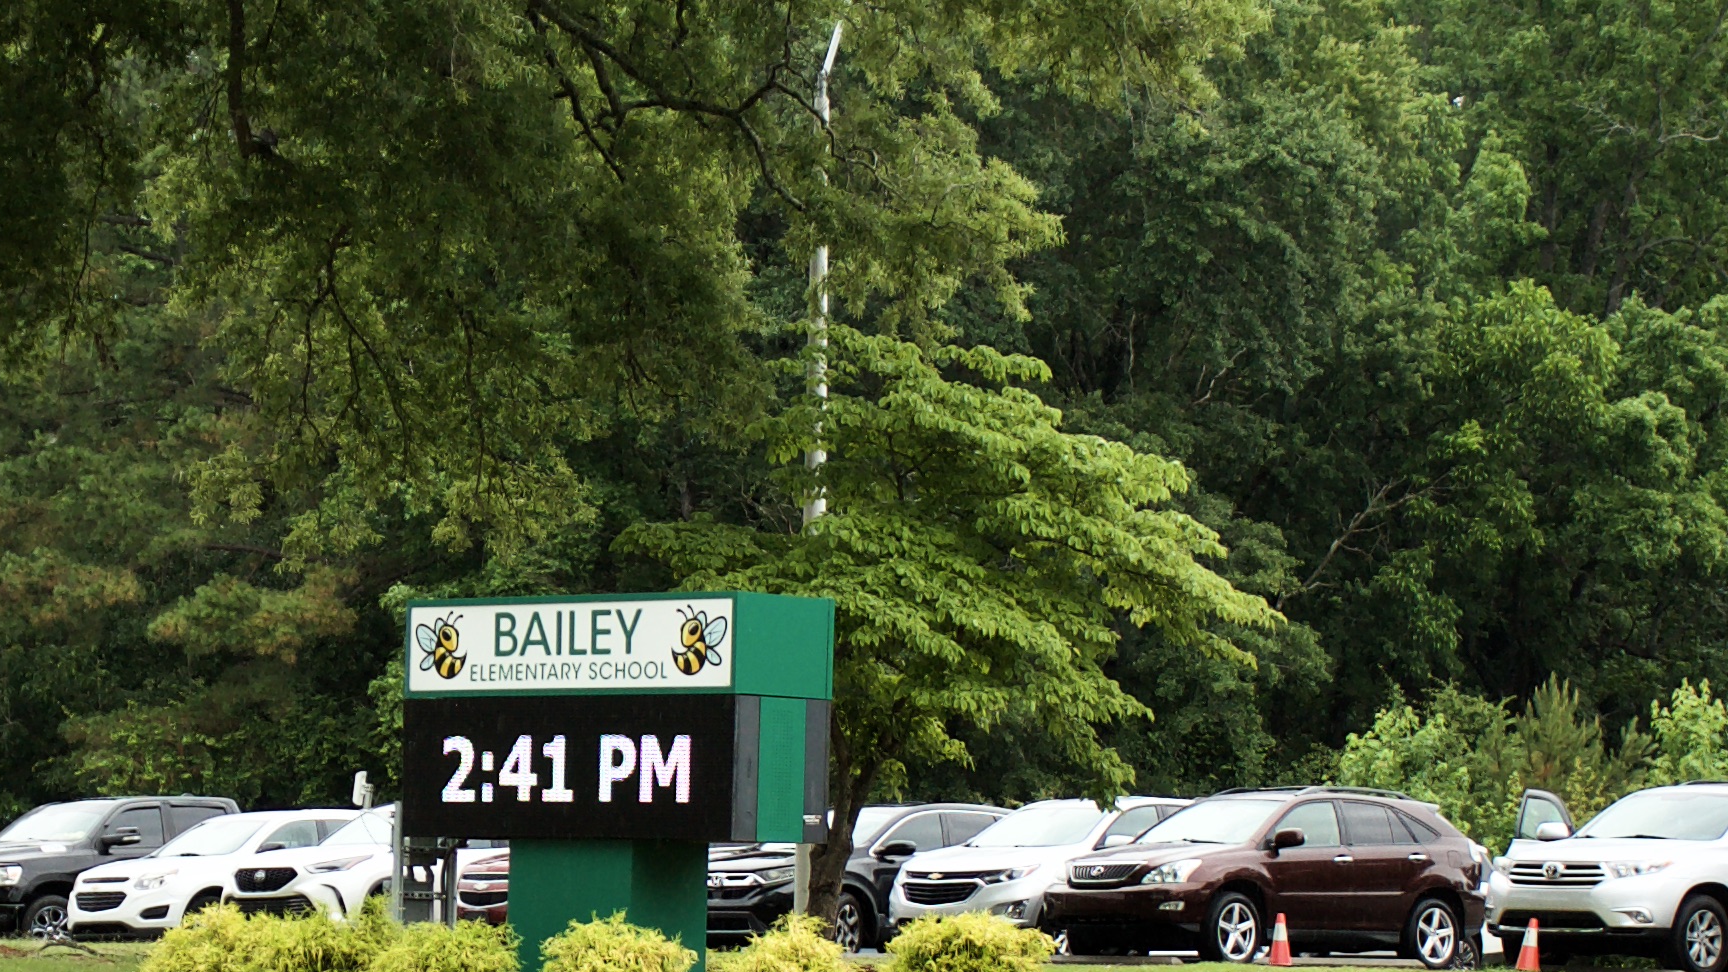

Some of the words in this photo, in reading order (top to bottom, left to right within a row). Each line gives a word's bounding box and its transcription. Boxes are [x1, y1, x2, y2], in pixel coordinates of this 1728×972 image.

[494, 608, 643, 657] BAILEY
[469, 662, 581, 682] ELEMENTARY
[588, 661, 668, 680] SCHOOL
[441, 735, 574, 803] 2:41
[598, 734, 692, 803] PM
